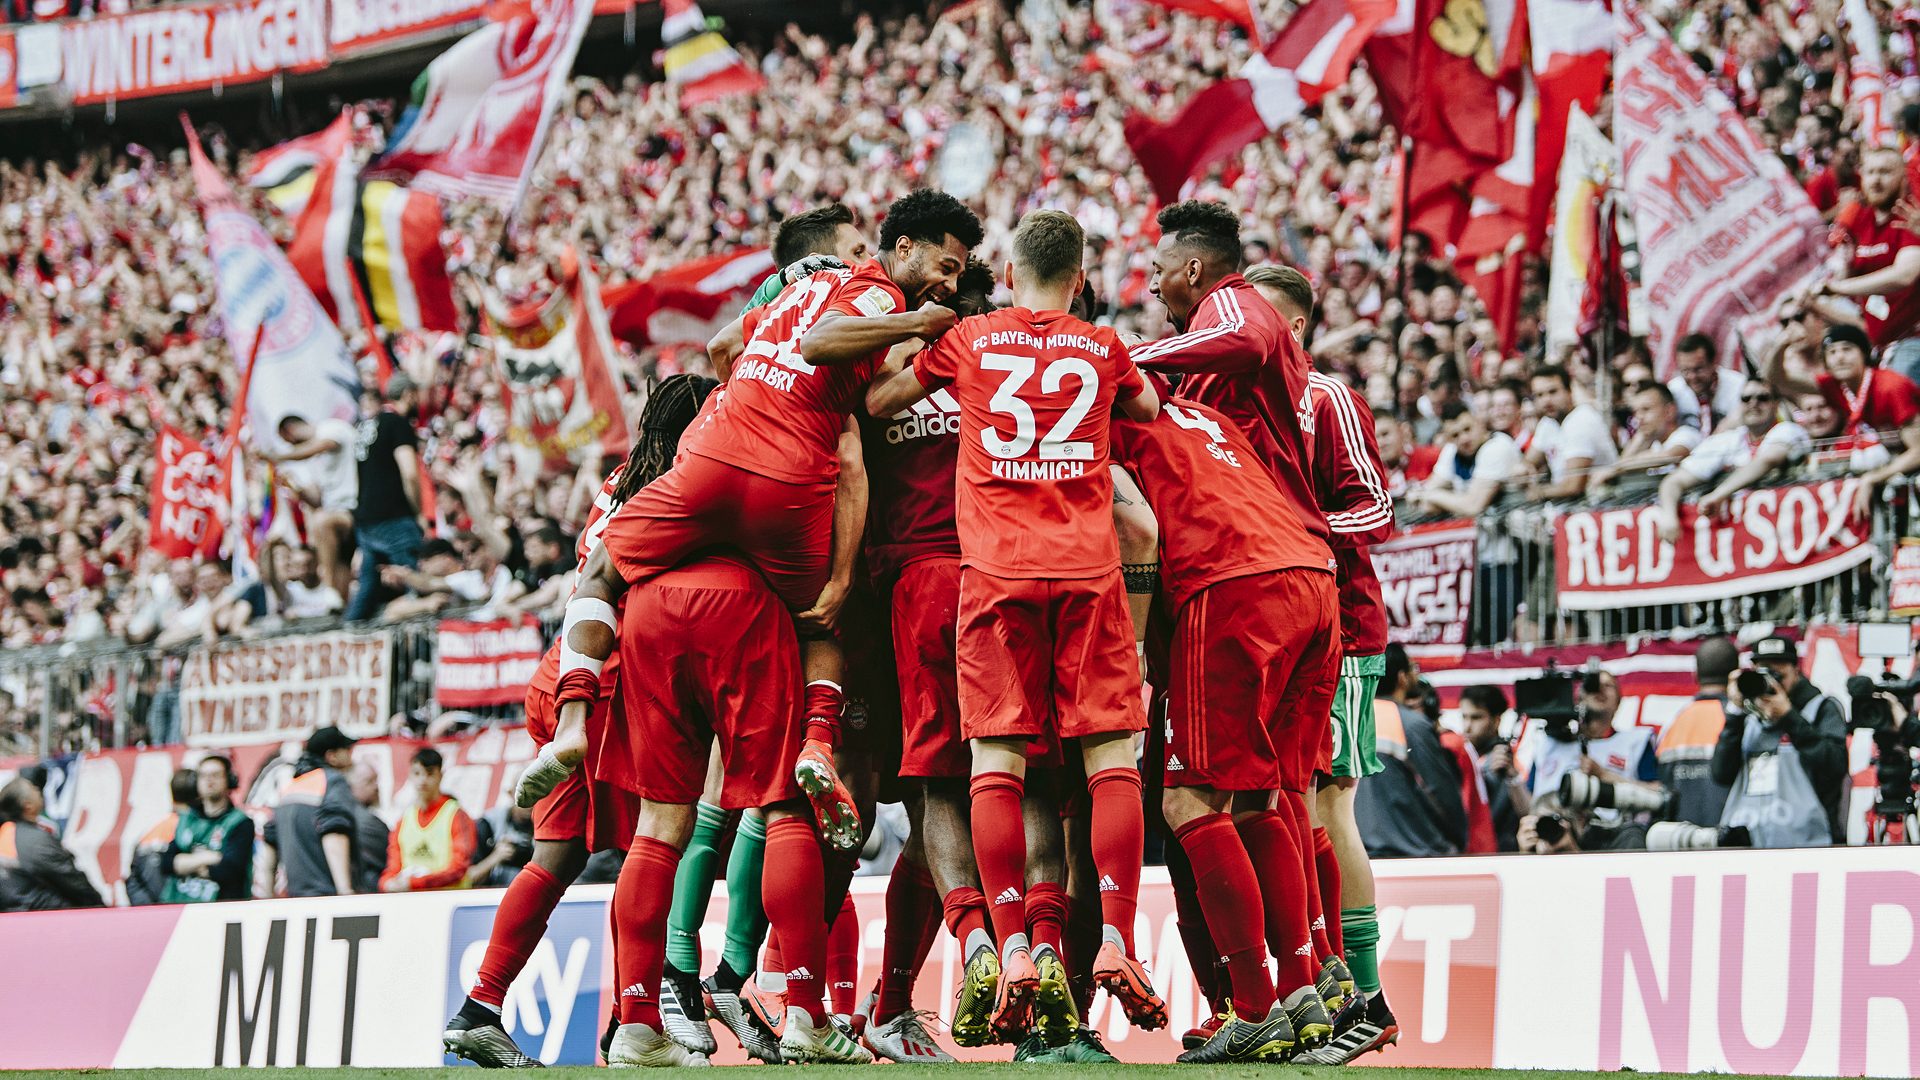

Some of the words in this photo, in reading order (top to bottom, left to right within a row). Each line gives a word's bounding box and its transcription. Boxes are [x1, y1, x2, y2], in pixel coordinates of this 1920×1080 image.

[972, 336, 988, 351] FC
[991, 331, 1043, 350] BAYERN
[1046, 334, 1110, 359] MÜNCHEN
[735, 359, 798, 393] GNABRY
[980, 352, 1099, 460] 32
[886, 411, 960, 444] adida
[1163, 402, 1228, 443] 4
[1297, 411, 1315, 436] adid
[991, 461, 1085, 481] KIMMICH
[1564, 504, 1675, 587] RED
[995, 894, 1023, 905] adidas
[834, 981, 854, 989] FCB
[893, 967, 912, 976] FCB
[1599, 870, 1920, 1078] NUR
[215, 915, 380, 1066] MIT
[621, 989, 649, 997] adidas
